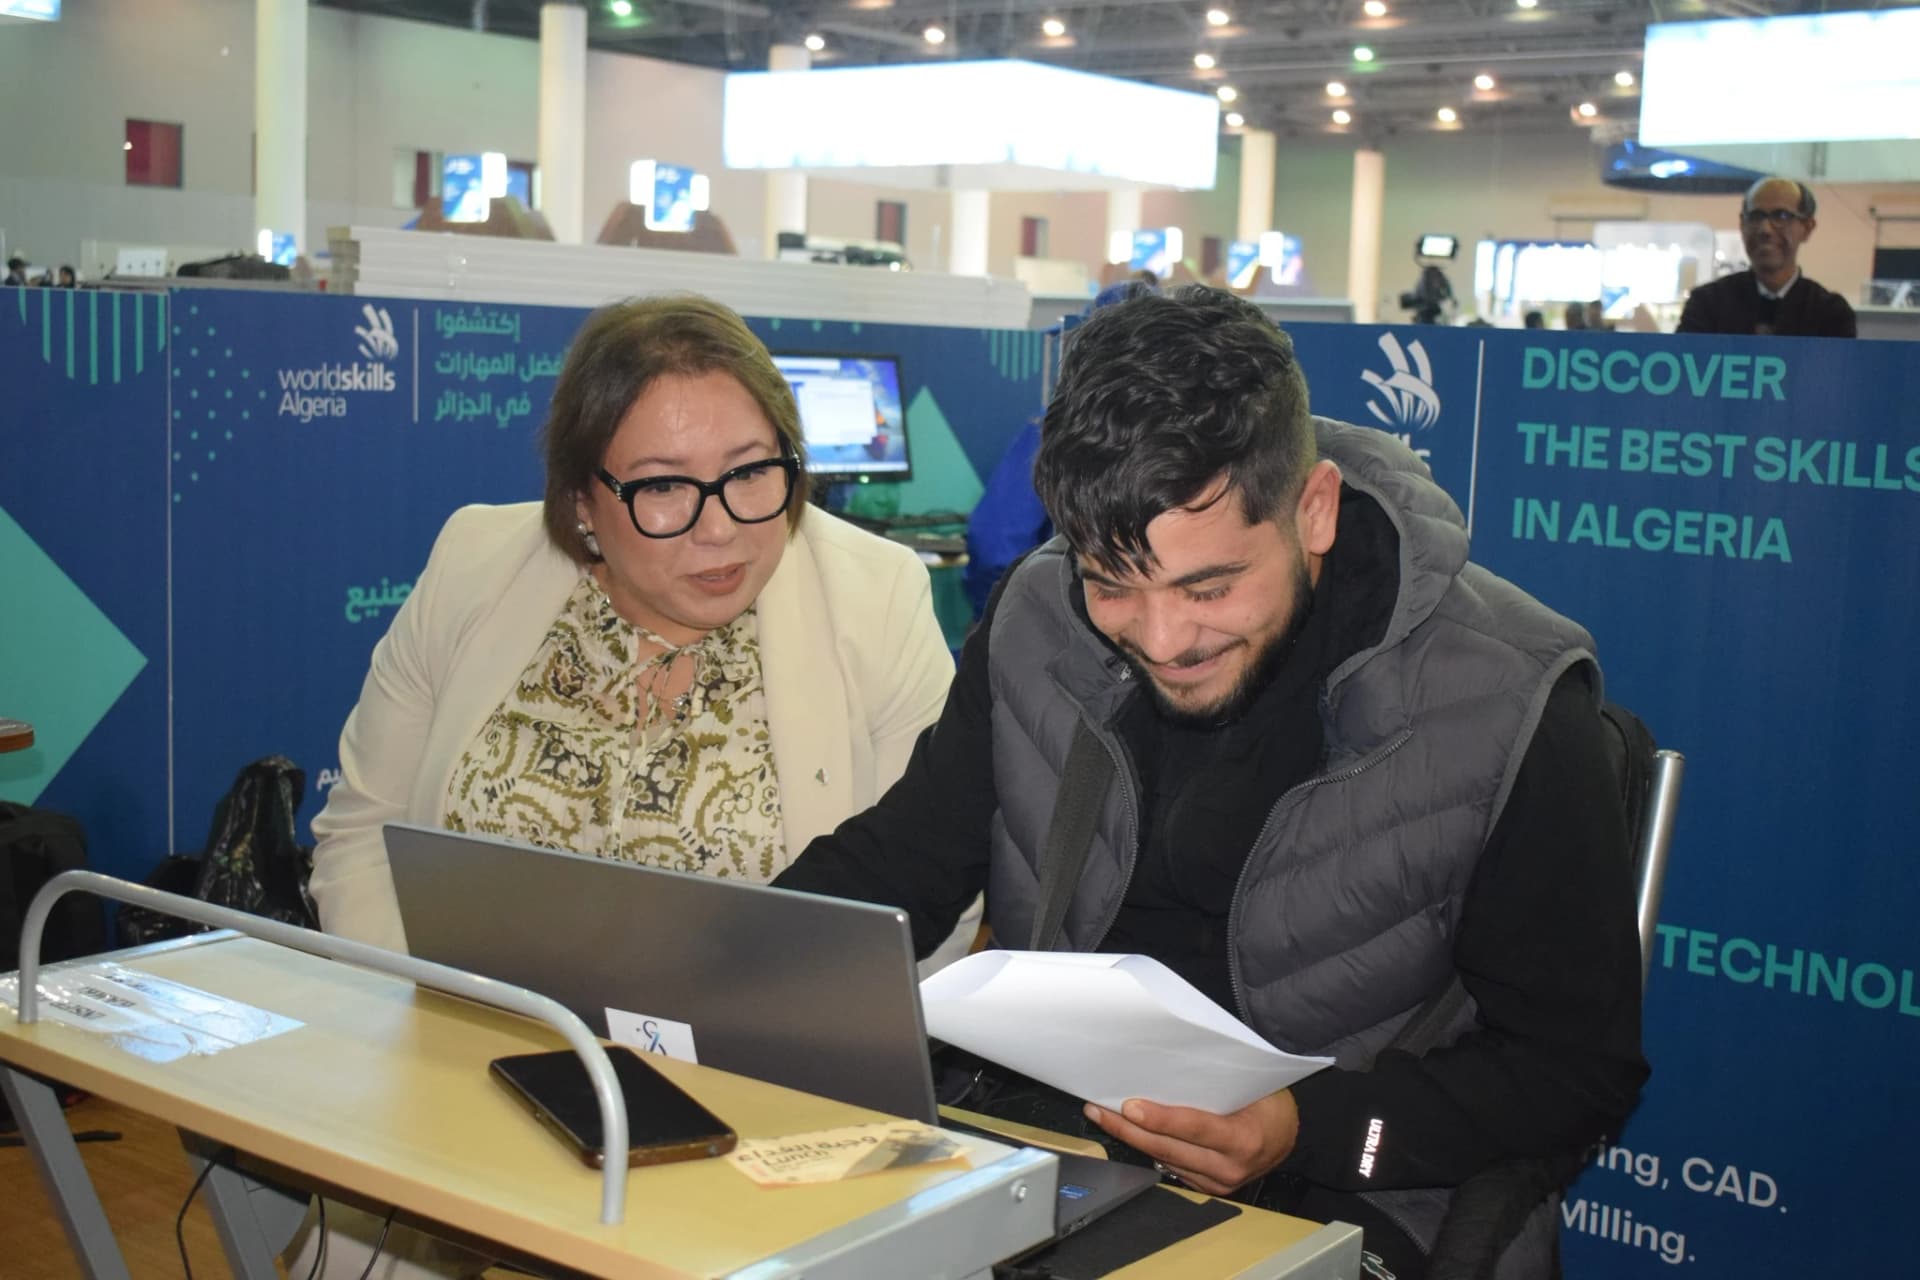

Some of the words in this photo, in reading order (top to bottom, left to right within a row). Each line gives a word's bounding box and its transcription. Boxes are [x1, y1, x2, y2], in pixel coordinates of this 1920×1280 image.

[278, 362, 397, 391] worldskills
[434, 351, 515, 382] المهارات
[519, 347, 568, 383] فضل
[1522, 347, 1787, 401] DISCOVER
[278, 391, 347, 423] Algeria
[434, 389, 492, 422] الجزائر
[495, 391, 532, 428] في
[1517, 422, 1610, 469] THE
[1620, 428, 1747, 479] BEST
[1512, 497, 1560, 543] IN
[1567, 502, 1793, 563] ALGERIA
[345, 576, 414, 624] صنيع
[1655, 923, 1920, 1018] TECHNOL
[1363, 1118, 1384, 1153] ULTRA
[1358, 1152, 1375, 1179] DRY
[1682, 1157, 1787, 1214] CAD.
[1561, 1198, 1696, 1265] Milling.
